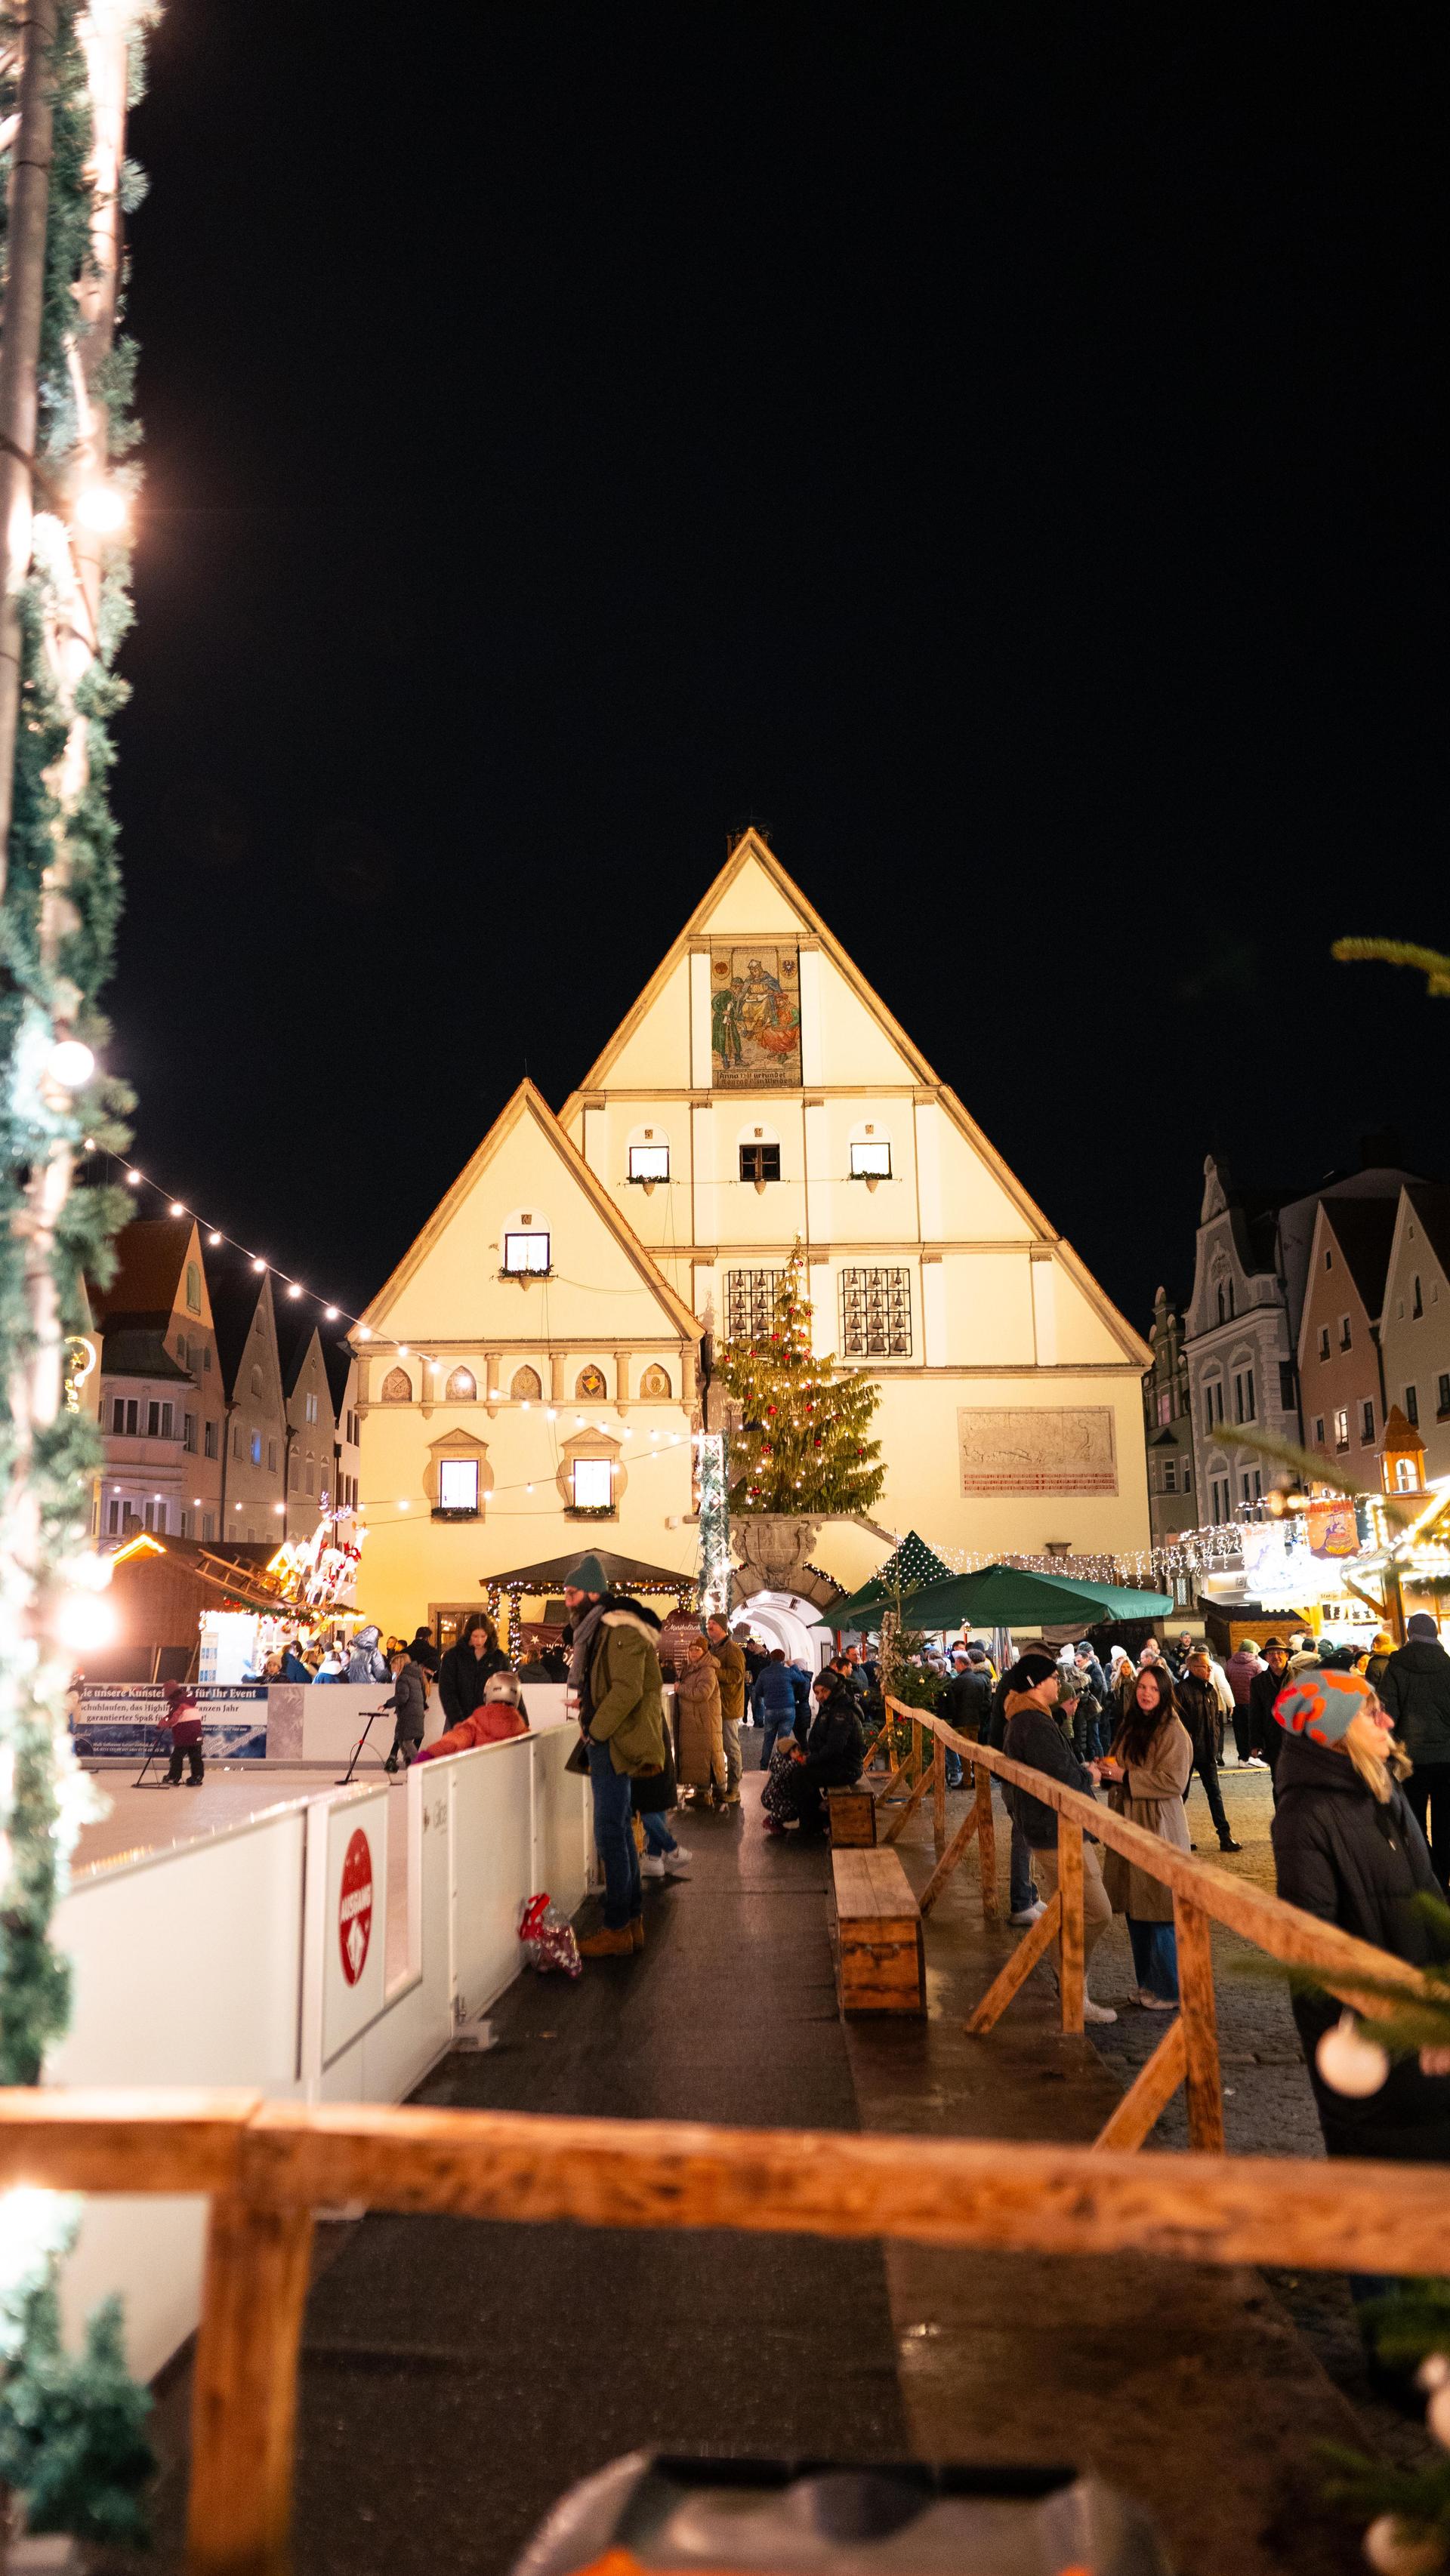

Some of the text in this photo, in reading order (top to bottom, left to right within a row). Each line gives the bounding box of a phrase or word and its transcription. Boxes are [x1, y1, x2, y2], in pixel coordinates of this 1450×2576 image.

[195, 1687, 209, 1697] für
[212, 1688, 228, 1697] Ihr
[230, 1689, 257, 1698] Event
[222, 1704, 239, 1712] Jahr
[87, 1714, 133, 1722] garantierter
[134, 1714, 153, 1722] Spaß
